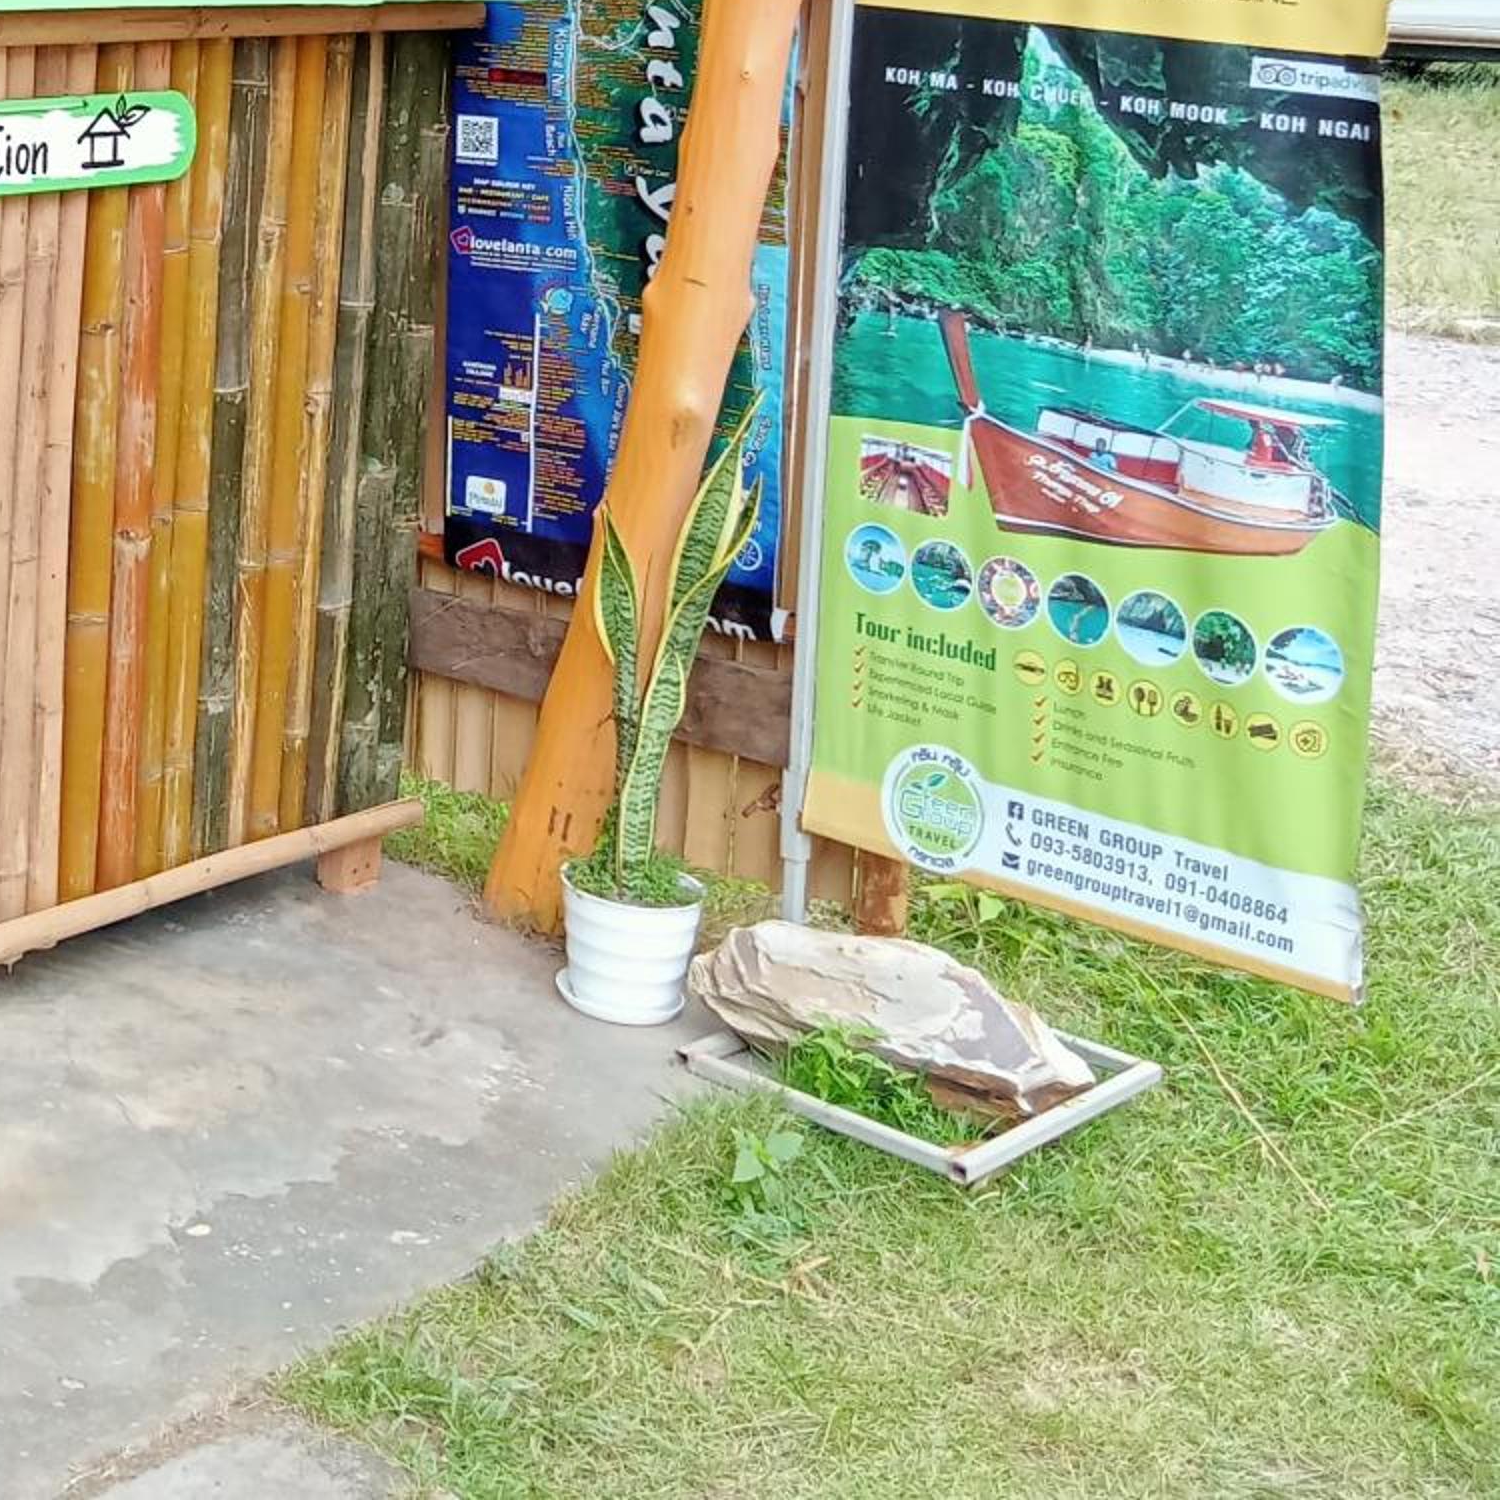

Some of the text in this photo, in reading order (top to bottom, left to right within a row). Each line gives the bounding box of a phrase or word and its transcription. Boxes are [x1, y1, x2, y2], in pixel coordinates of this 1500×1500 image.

[885, 67, 1372, 142] KOH MA KOH KOH MOOK KOH NGAI
[855, 611, 901, 643] Tour
[907, 626, 997, 671] included
[1031, 808, 1230, 883] GREEN GROUP Travel
